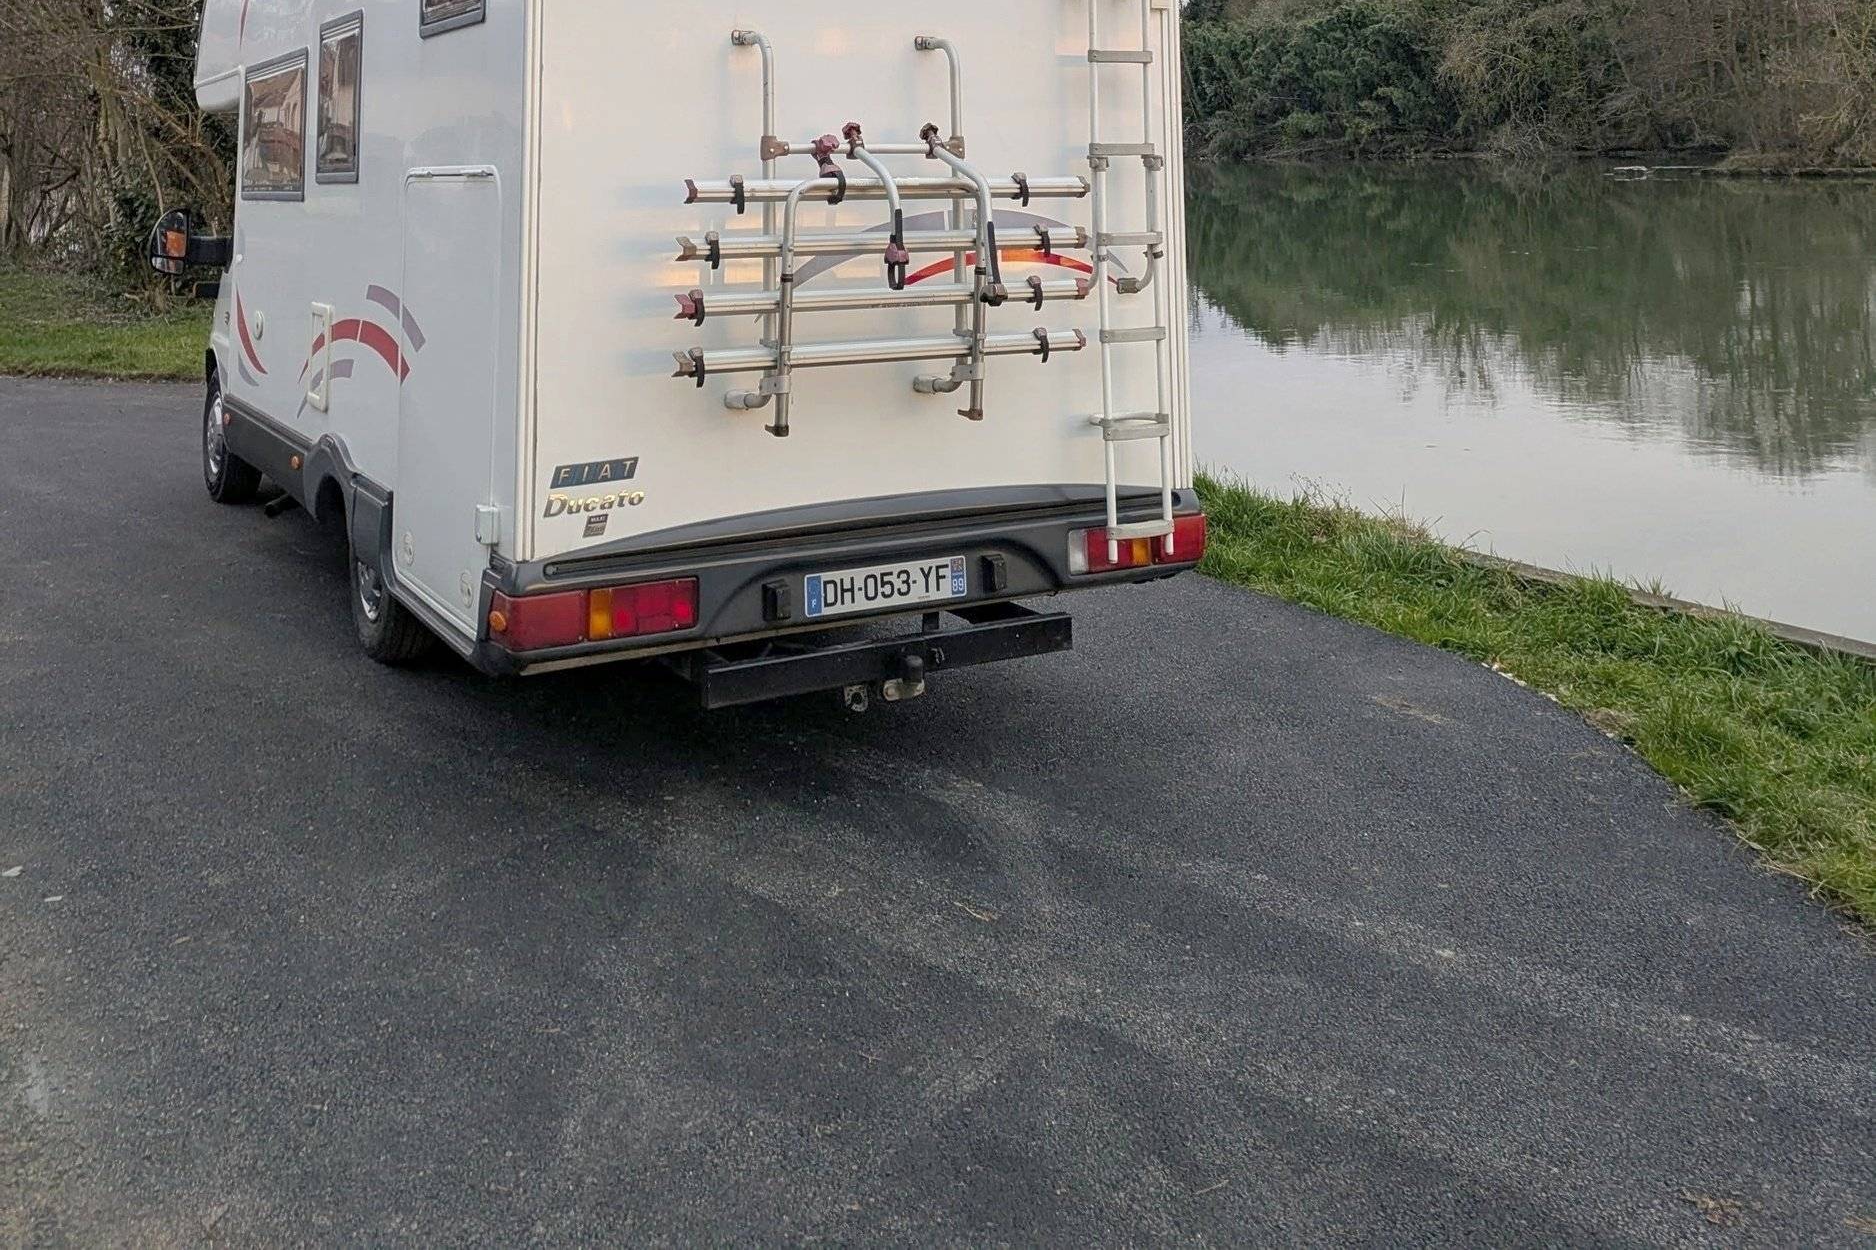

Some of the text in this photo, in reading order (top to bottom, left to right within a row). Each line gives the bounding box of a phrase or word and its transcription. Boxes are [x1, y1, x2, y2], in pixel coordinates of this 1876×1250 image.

[558, 461, 633, 485] FIAT
[543, 489, 645, 519] Ducato
[823, 565, 950, 608] DH-053-YF
